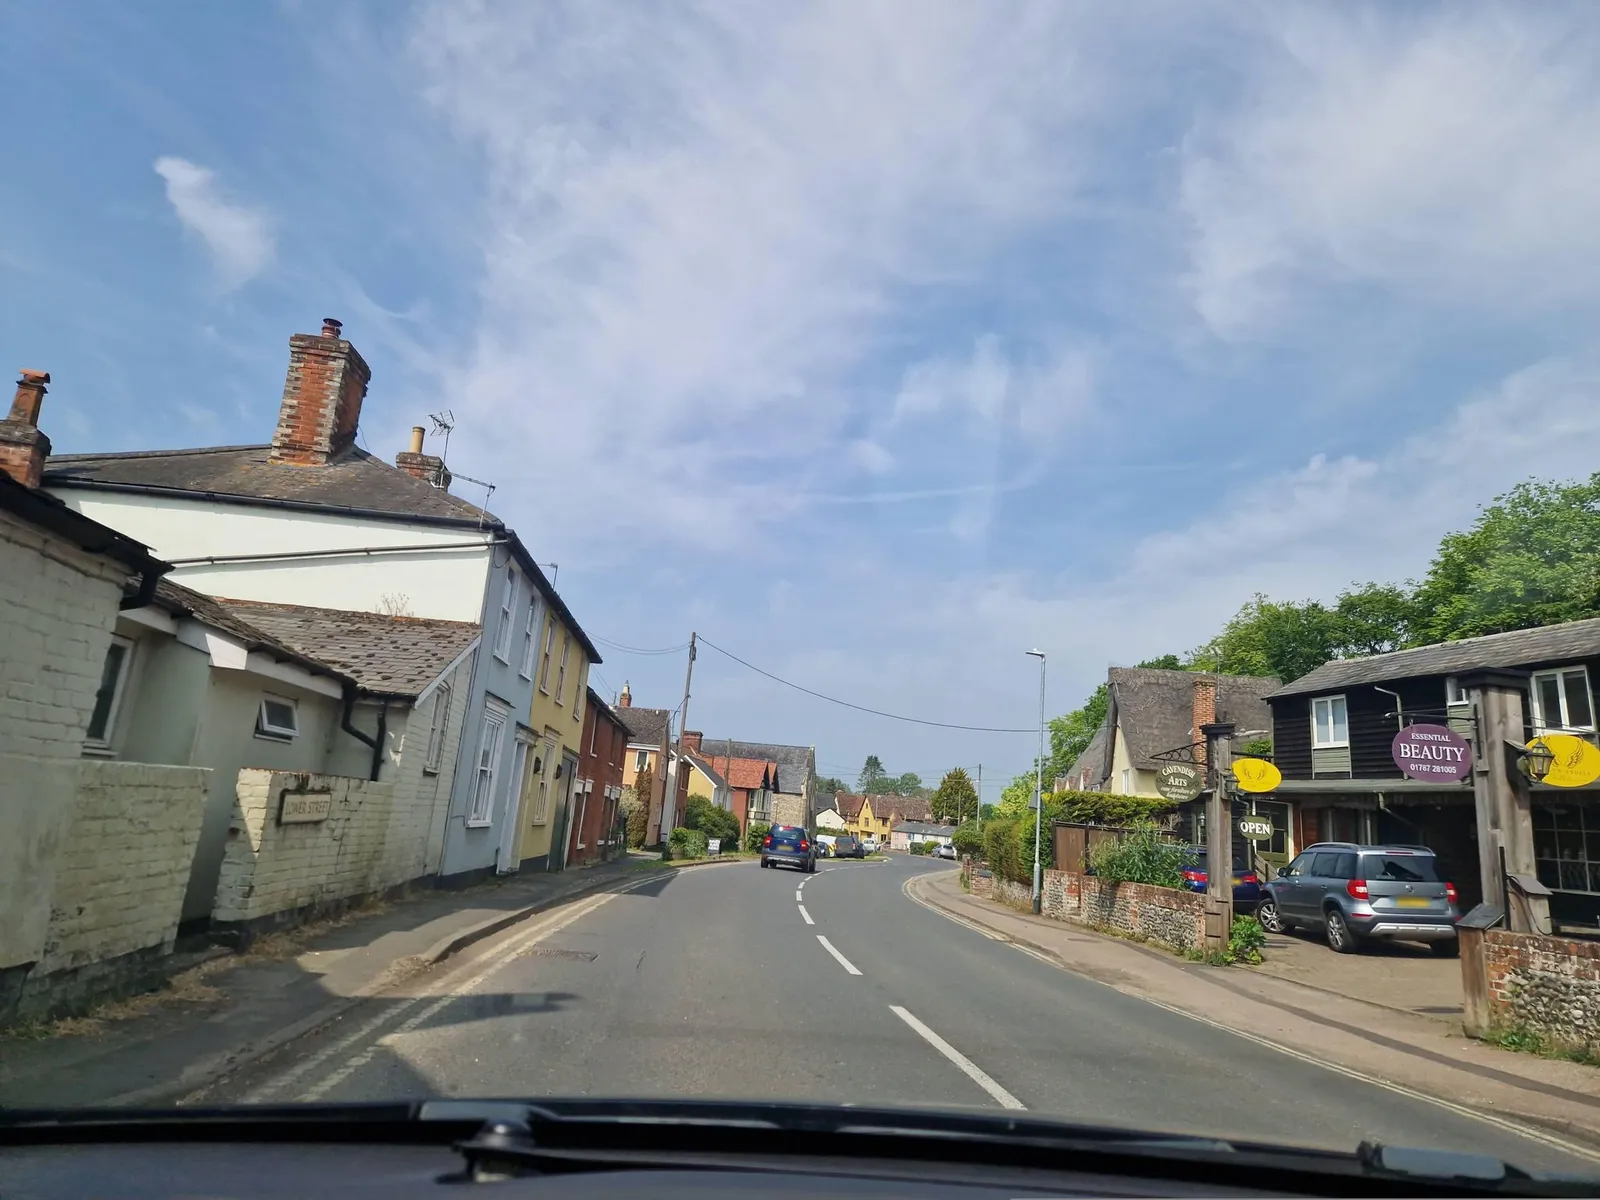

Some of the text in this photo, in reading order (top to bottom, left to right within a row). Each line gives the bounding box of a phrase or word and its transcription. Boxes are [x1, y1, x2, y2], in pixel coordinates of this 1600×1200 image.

[1411, 732, 1451, 742] ESSENTIAL
[1400, 743, 1464, 762] BEAUTY
[1162, 765, 1196, 779] CAVENDISH
[1410, 763, 1457, 774] 01787 281005
[285, 801, 330, 815] LOWER STREET
[1240, 821, 1271, 835] OPEN
